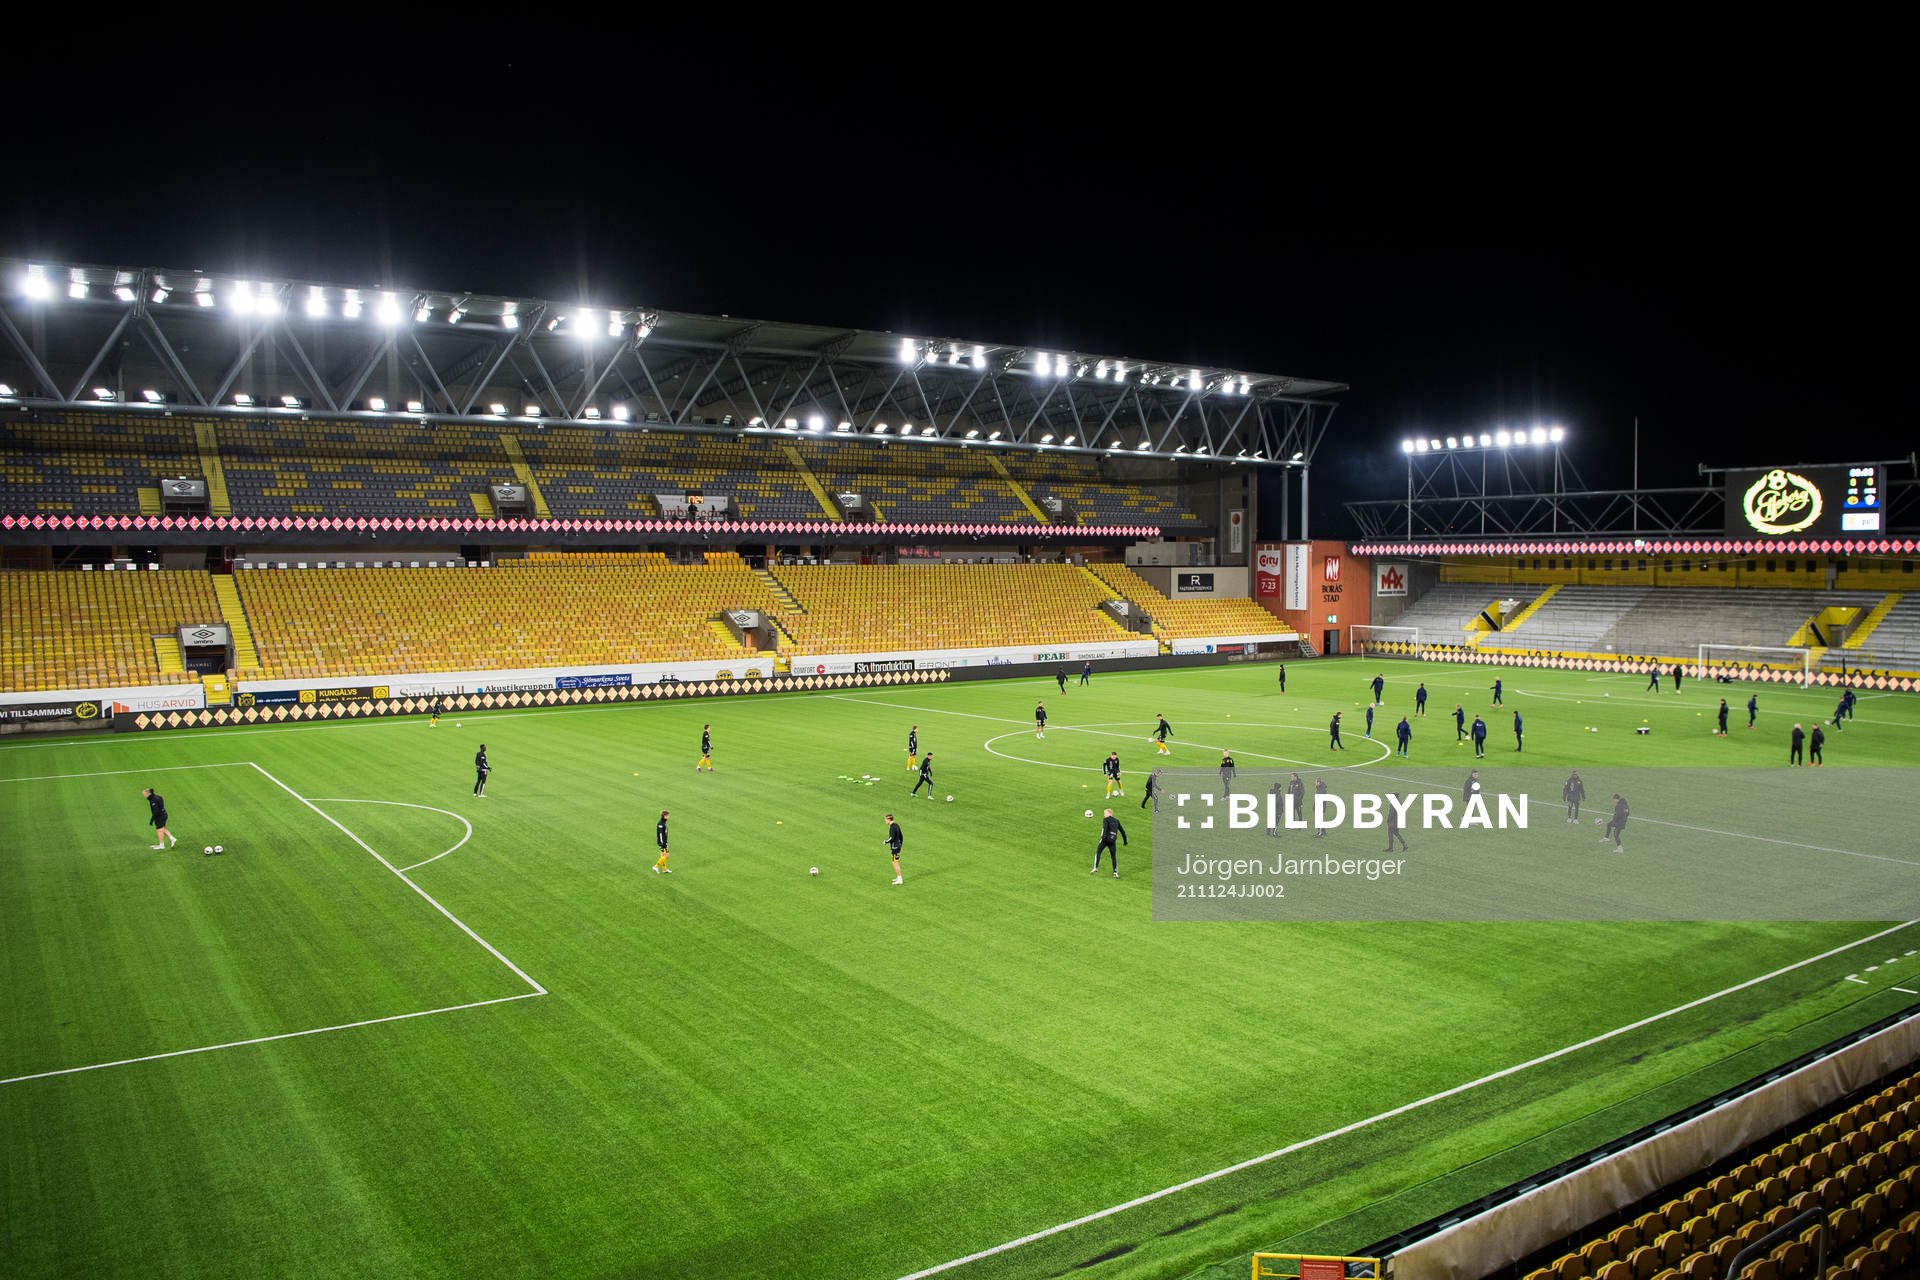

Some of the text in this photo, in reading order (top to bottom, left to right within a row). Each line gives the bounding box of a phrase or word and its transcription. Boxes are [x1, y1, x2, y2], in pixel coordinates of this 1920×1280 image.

[1259, 554, 1279, 567] City
[1381, 566, 1403, 589] MAX
[1321, 584, 1343, 593] BORÅS
[1324, 594, 1340, 602] STAD
[1038, 652, 1066, 661] PEAB
[793, 666, 816, 675] COMFORT
[484, 683, 554, 693] Akustikgruppen
[10, 707, 72, 718] TILLSAMMANS
